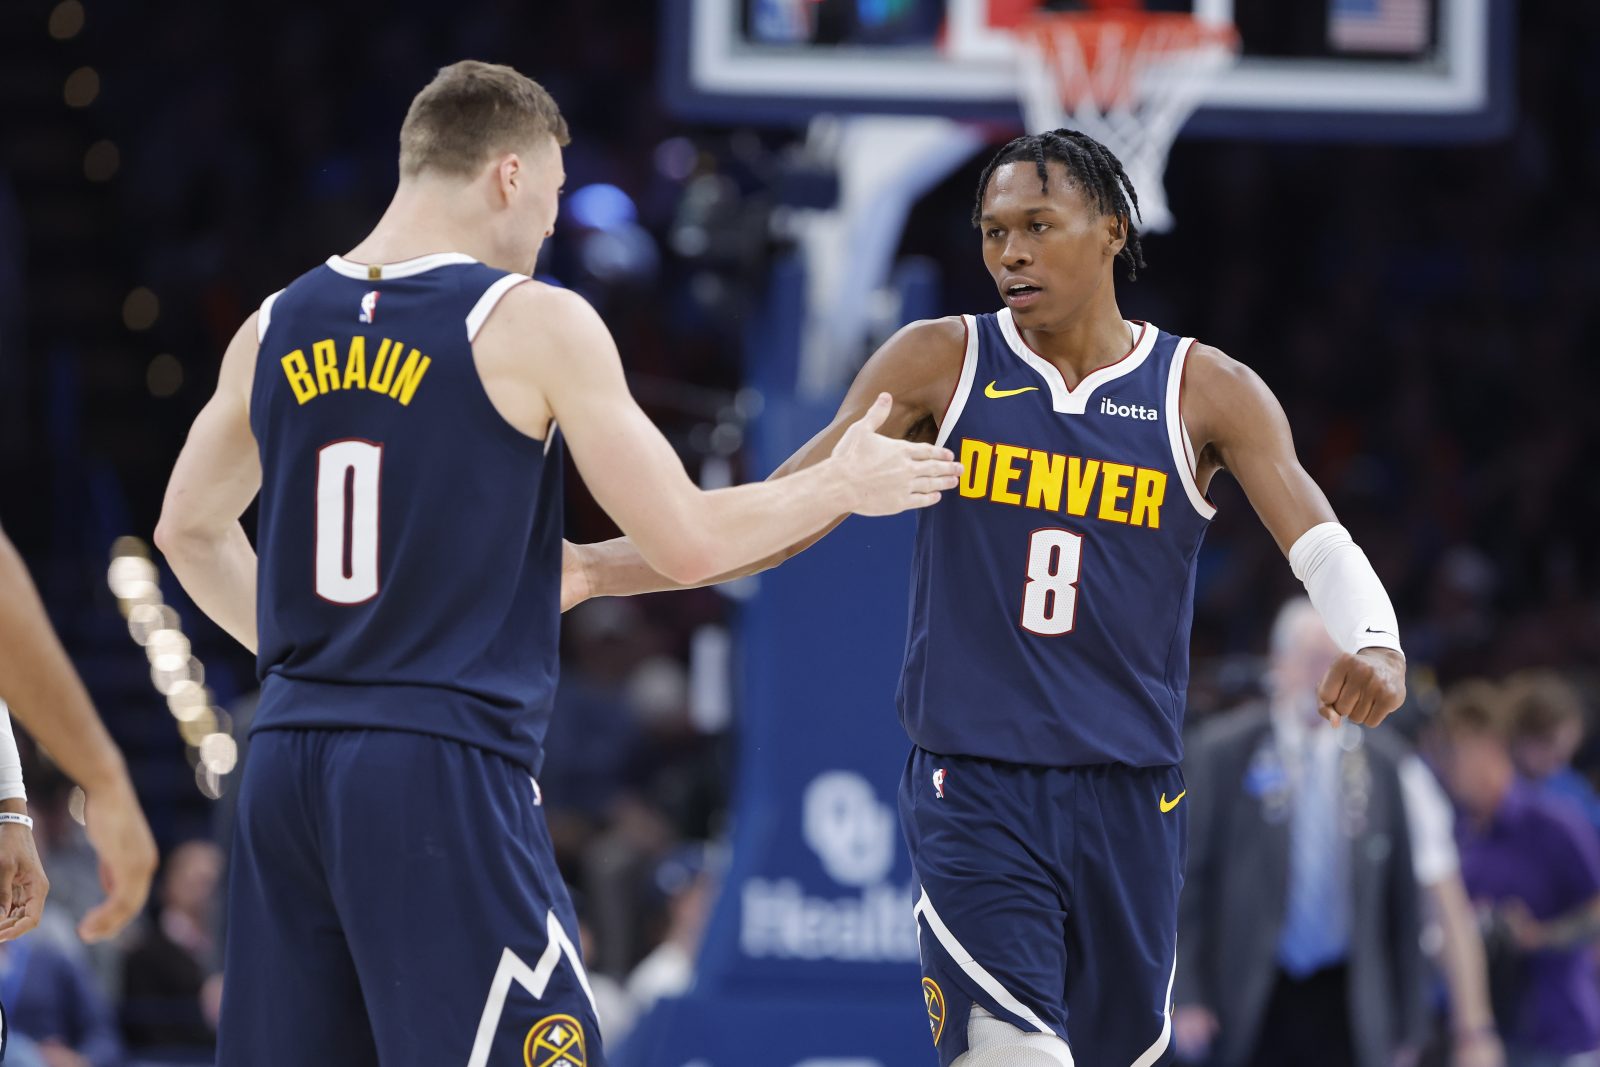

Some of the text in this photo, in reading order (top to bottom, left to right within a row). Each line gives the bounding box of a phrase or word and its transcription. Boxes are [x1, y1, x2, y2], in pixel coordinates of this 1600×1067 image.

[281, 336, 432, 406] BRAUN
[1100, 397, 1158, 421] ibotta
[314, 437, 384, 606] 0
[958, 437, 1169, 530] DENVER
[1019, 526, 1085, 637] 8
